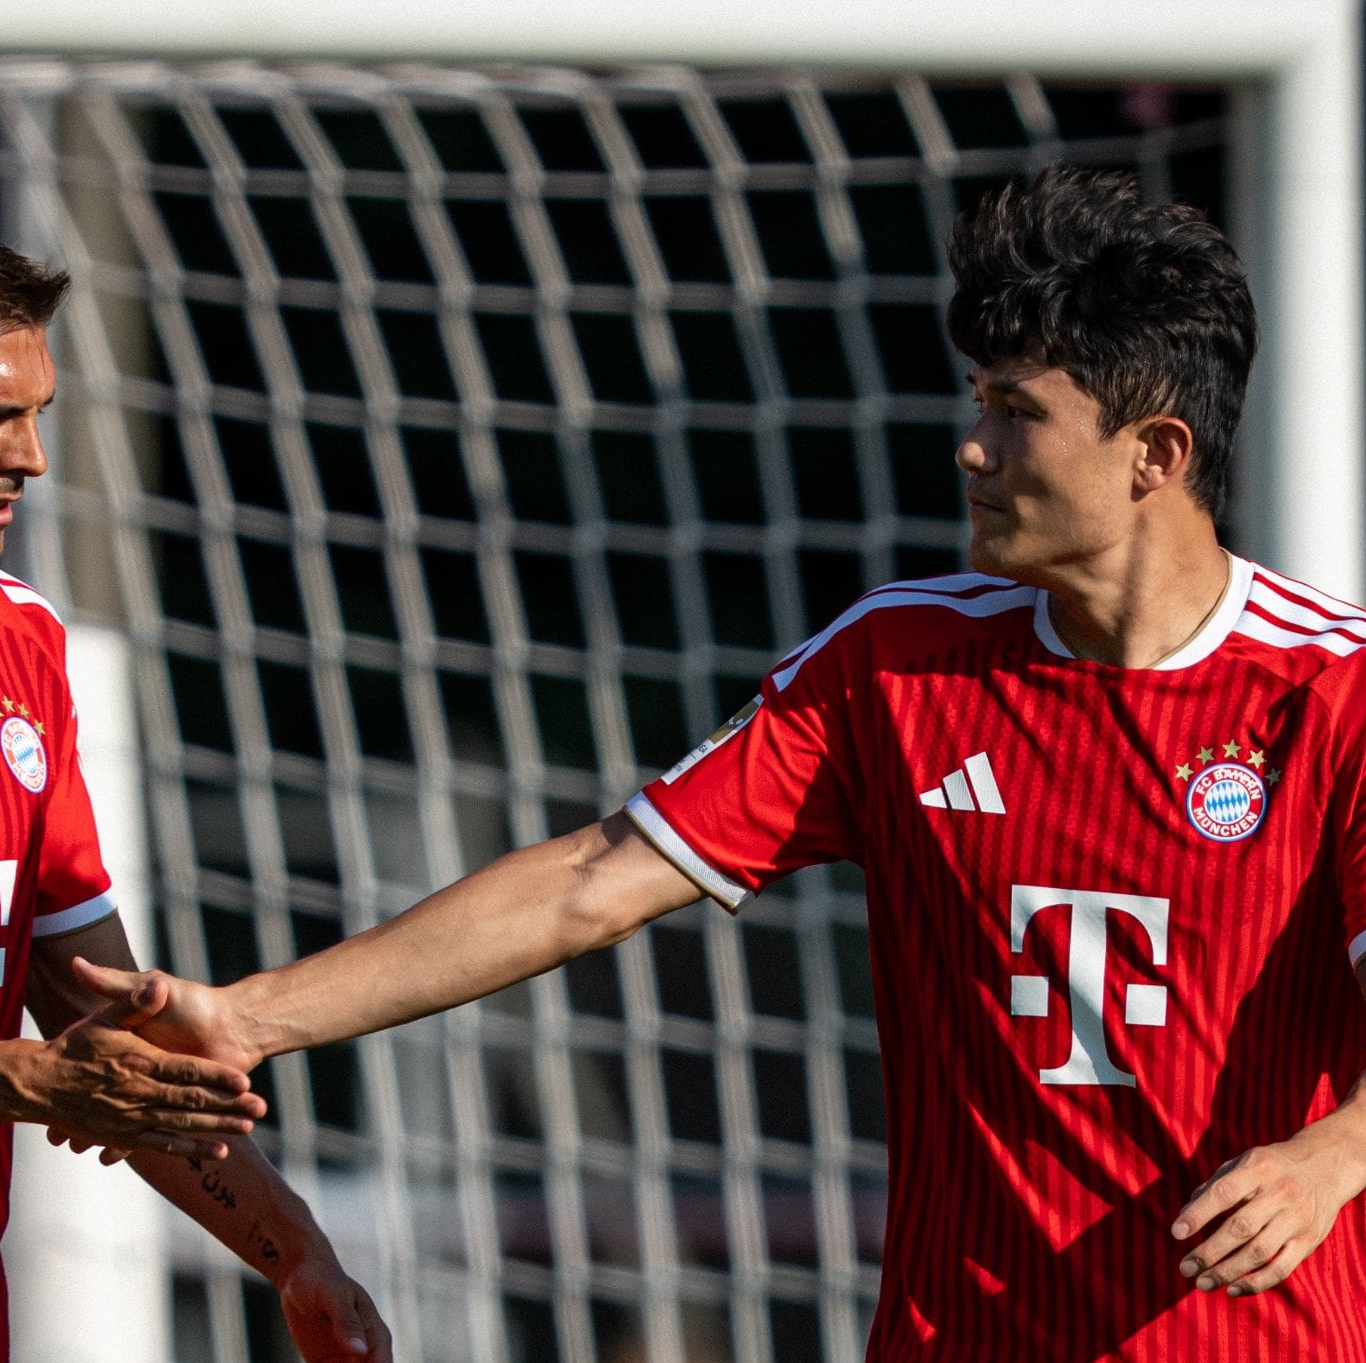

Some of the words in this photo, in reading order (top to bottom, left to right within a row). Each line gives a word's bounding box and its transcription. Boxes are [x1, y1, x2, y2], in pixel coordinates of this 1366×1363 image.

[1196, 777, 1212, 795] FC
[1214, 768, 1261, 799] BAYERN
[1011, 885, 1170, 1088] T
